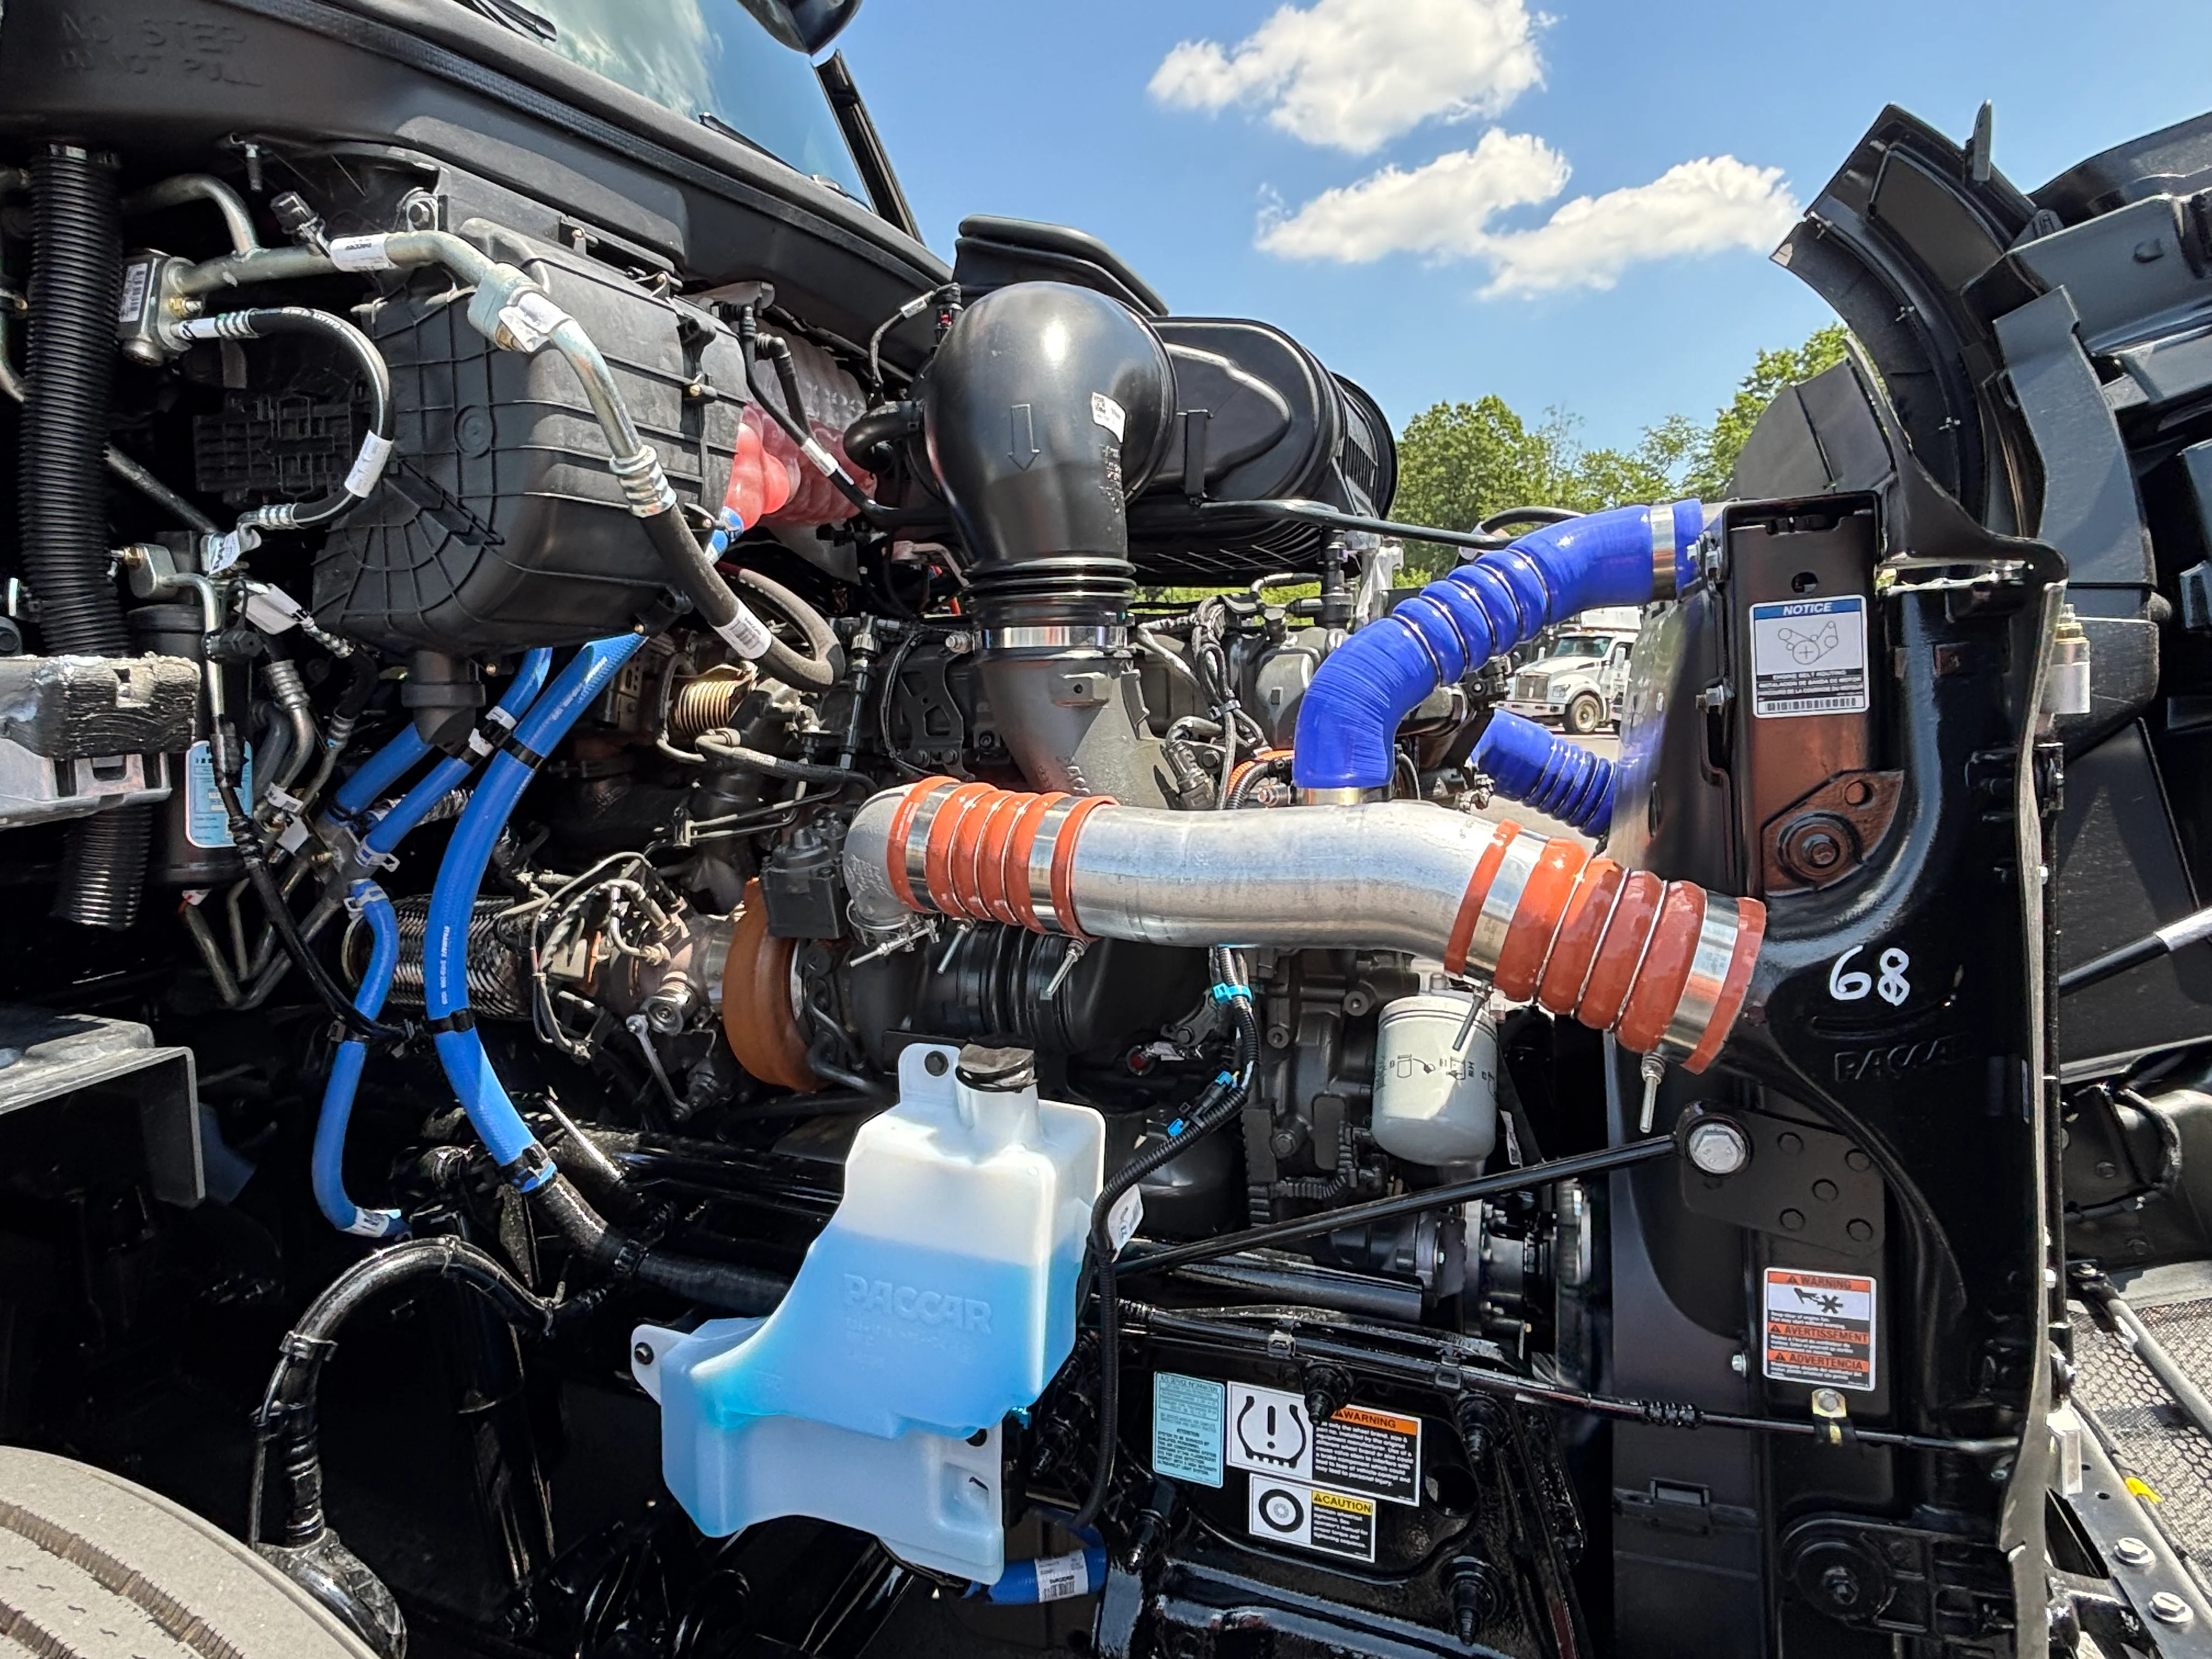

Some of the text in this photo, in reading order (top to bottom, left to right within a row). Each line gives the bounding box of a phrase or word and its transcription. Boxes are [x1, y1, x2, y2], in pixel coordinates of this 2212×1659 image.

[63, 12, 249, 54] NO STEP
[182, 59, 264, 88] PULL
[1783, 602, 1832, 616] NOTICE
[1830, 945, 1910, 1006] 68
[1801, 1275, 1852, 1289] WARNING
[843, 1273, 992, 1334] PACCAR
[1785, 1325, 1867, 1342] AVERTISSEMENT
[1790, 1353, 1863, 1370] ADVERTENCIA
[1344, 1410, 1396, 1428] WARNING
[1323, 1496, 1371, 1513] CAUTION
